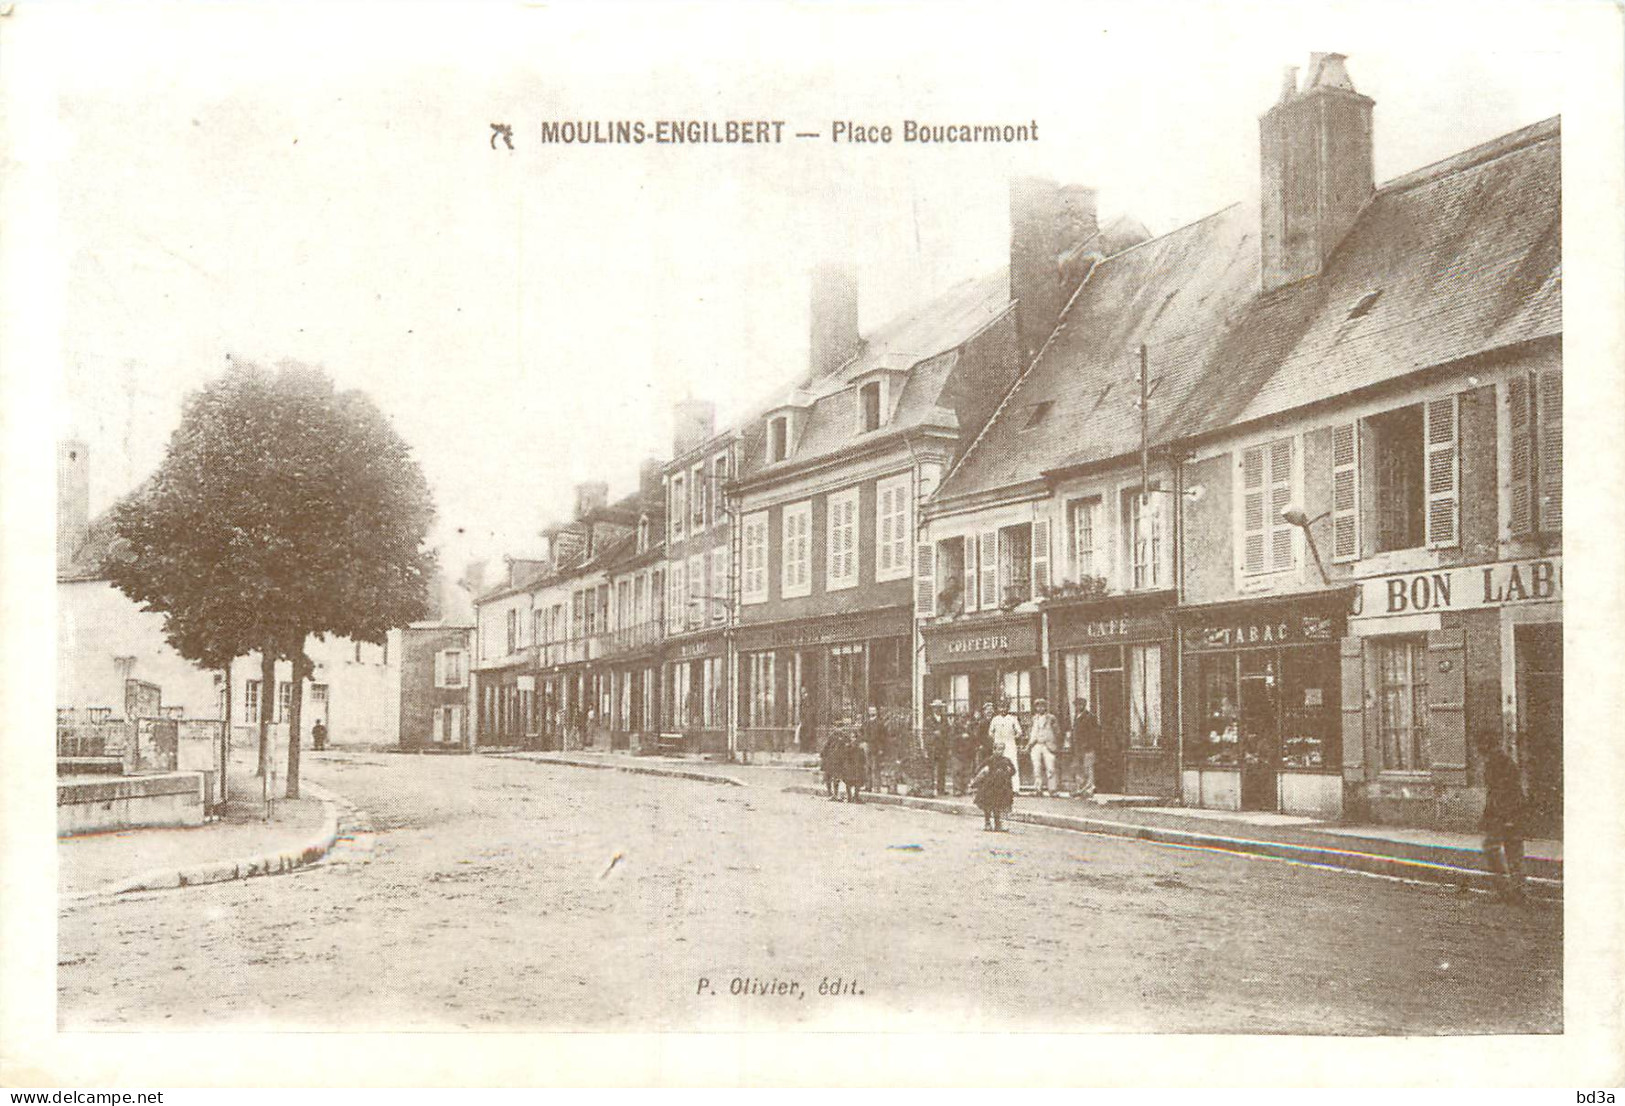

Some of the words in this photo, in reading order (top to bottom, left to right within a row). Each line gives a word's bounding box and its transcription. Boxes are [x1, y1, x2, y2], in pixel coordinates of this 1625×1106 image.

[1386, 573, 1452, 613] BON
[1481, 560, 1563, 604] LAB
[1087, 615, 1128, 637] CAFÉ
[1223, 624, 1288, 645] TABAC
[948, 636, 1008, 653] COIFFEUR
